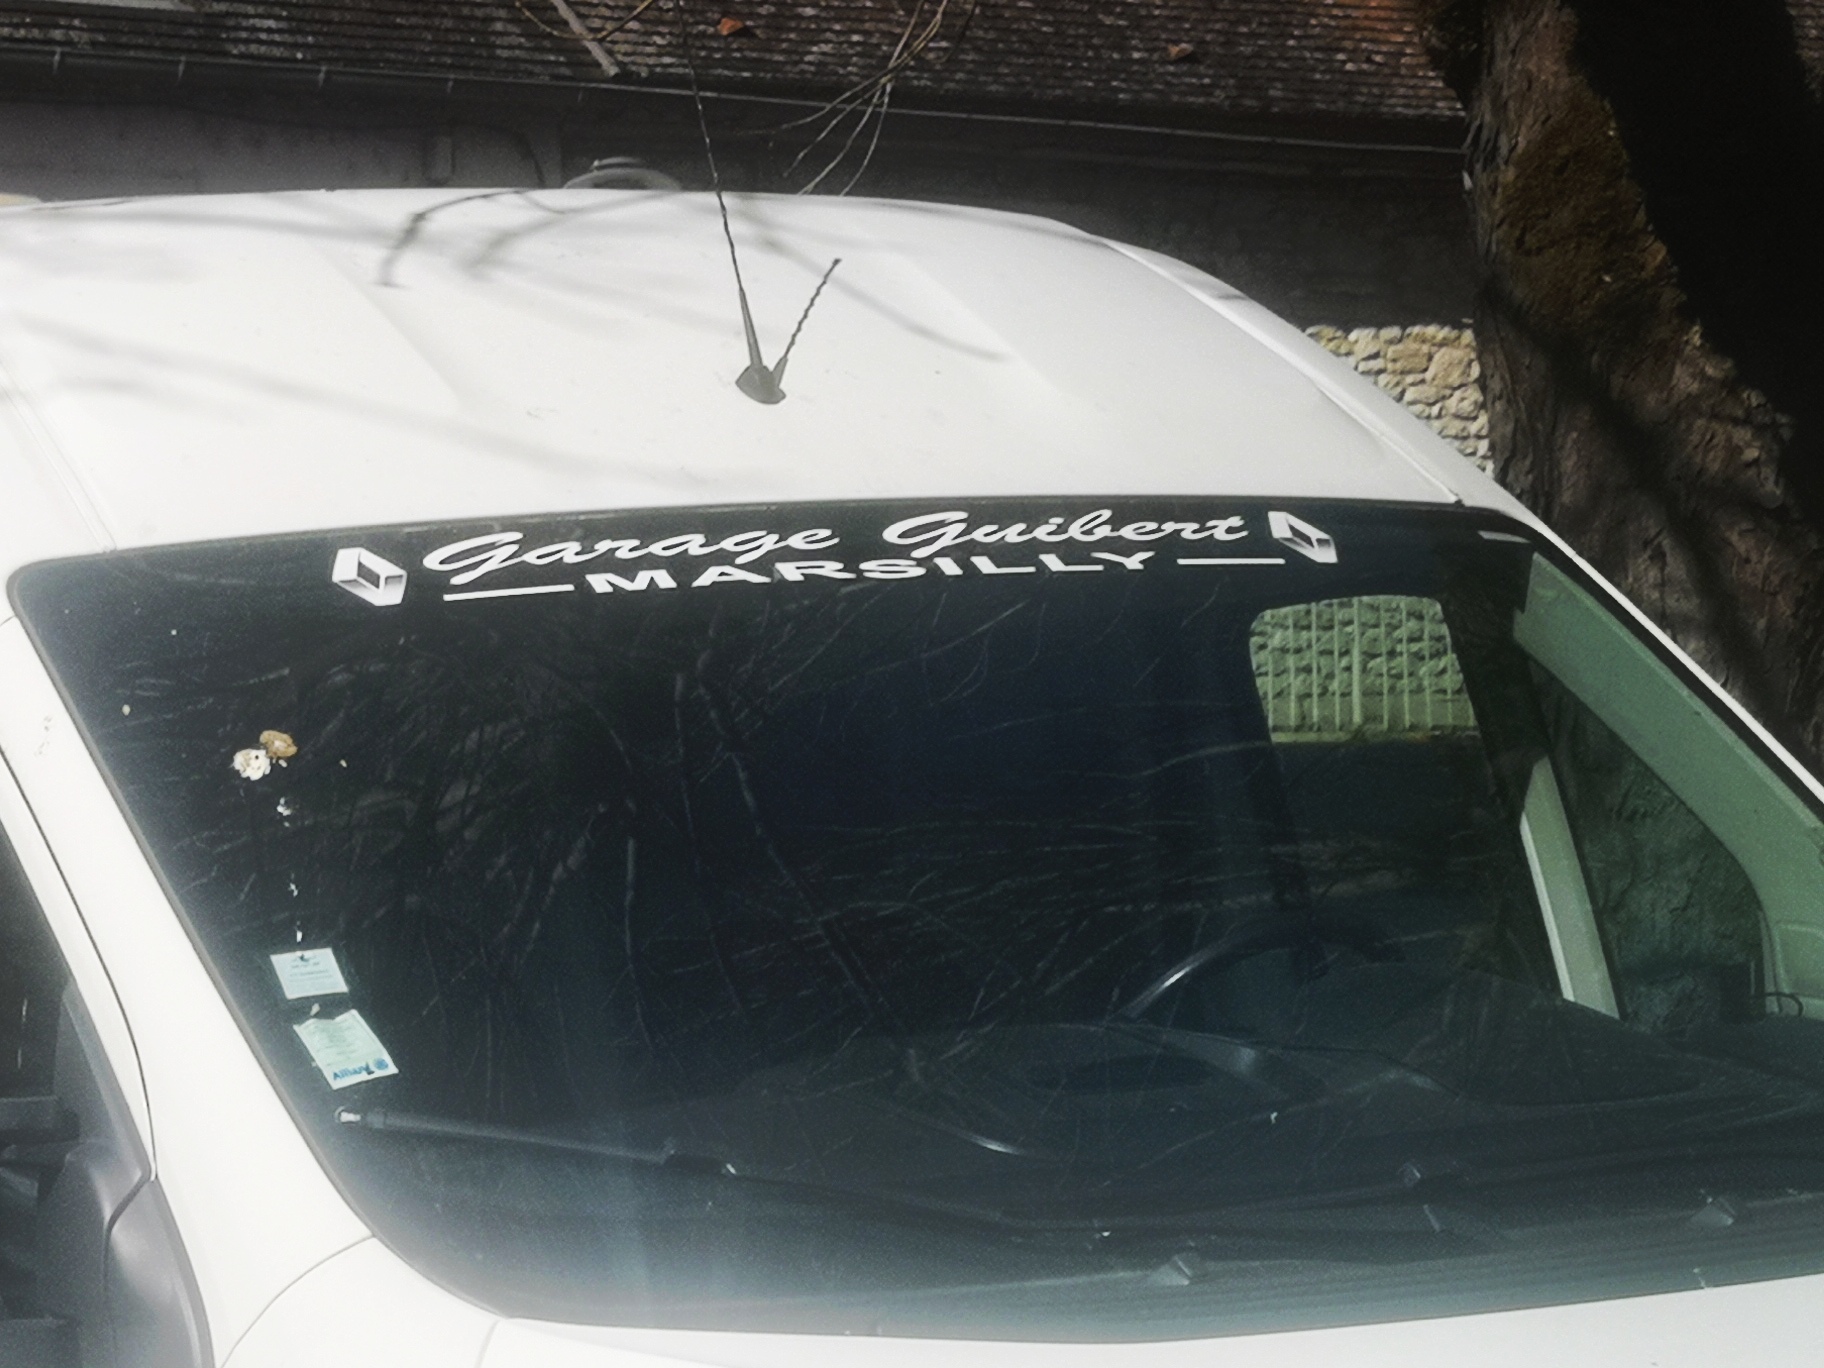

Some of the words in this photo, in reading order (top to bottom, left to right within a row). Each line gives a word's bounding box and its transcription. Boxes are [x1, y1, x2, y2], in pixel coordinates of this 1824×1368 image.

[422, 529, 840, 586] Garage
[881, 508, 1249, 559] Guibert
[584, 551, 1156, 594] MARSILLY
